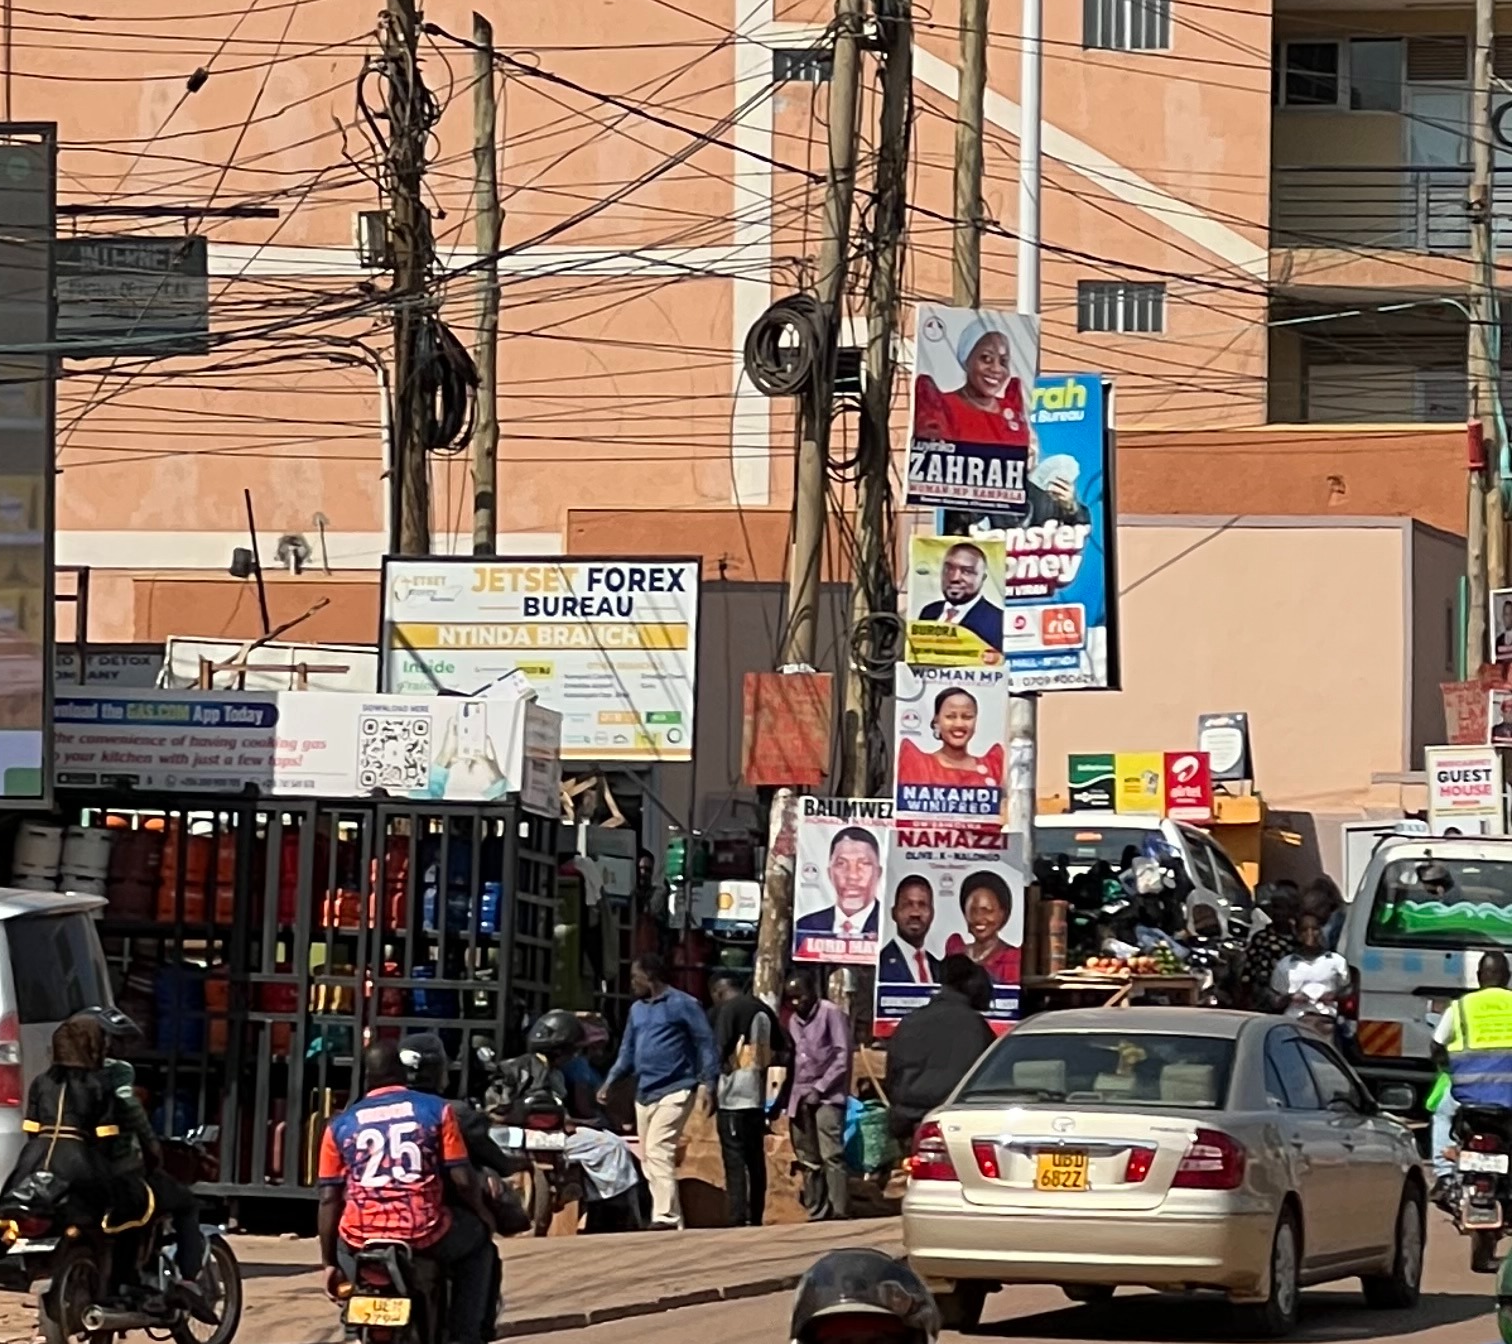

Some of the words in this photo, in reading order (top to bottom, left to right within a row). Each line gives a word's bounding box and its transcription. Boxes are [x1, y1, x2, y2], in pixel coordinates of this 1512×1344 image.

[909, 452, 1025, 489] ZAHRAH
[471, 568, 580, 593] JETSET
[588, 568, 686, 593] FOREX
[524, 596, 634, 618] BUREAU
[1048, 613, 1076, 634] ria
[438, 625, 531, 646] NTINDA
[537, 625, 640, 647] BRANCH
[912, 668, 976, 681] WOMAN
[981, 672, 1004, 683] MP
[192, 706, 221, 724] App
[225, 707, 264, 725] Today
[190, 736, 236, 750] having
[241, 737, 297, 751] cooking
[302, 741, 327, 751] gas
[64, 752, 96, 764] your
[101, 751, 152, 764] kitchen
[159, 752, 189, 765] with
[192, 753, 221, 767] just
[238, 754, 263, 766] few
[1437, 768, 1492, 783] GUEST
[903, 785, 999, 804] NAKANDI
[1440, 784, 1492, 796] HOUSE
[907, 800, 992, 814] WINIFRED
[897, 829, 1008, 850] NAMAZZI
[355, 1121, 422, 1188] 25
